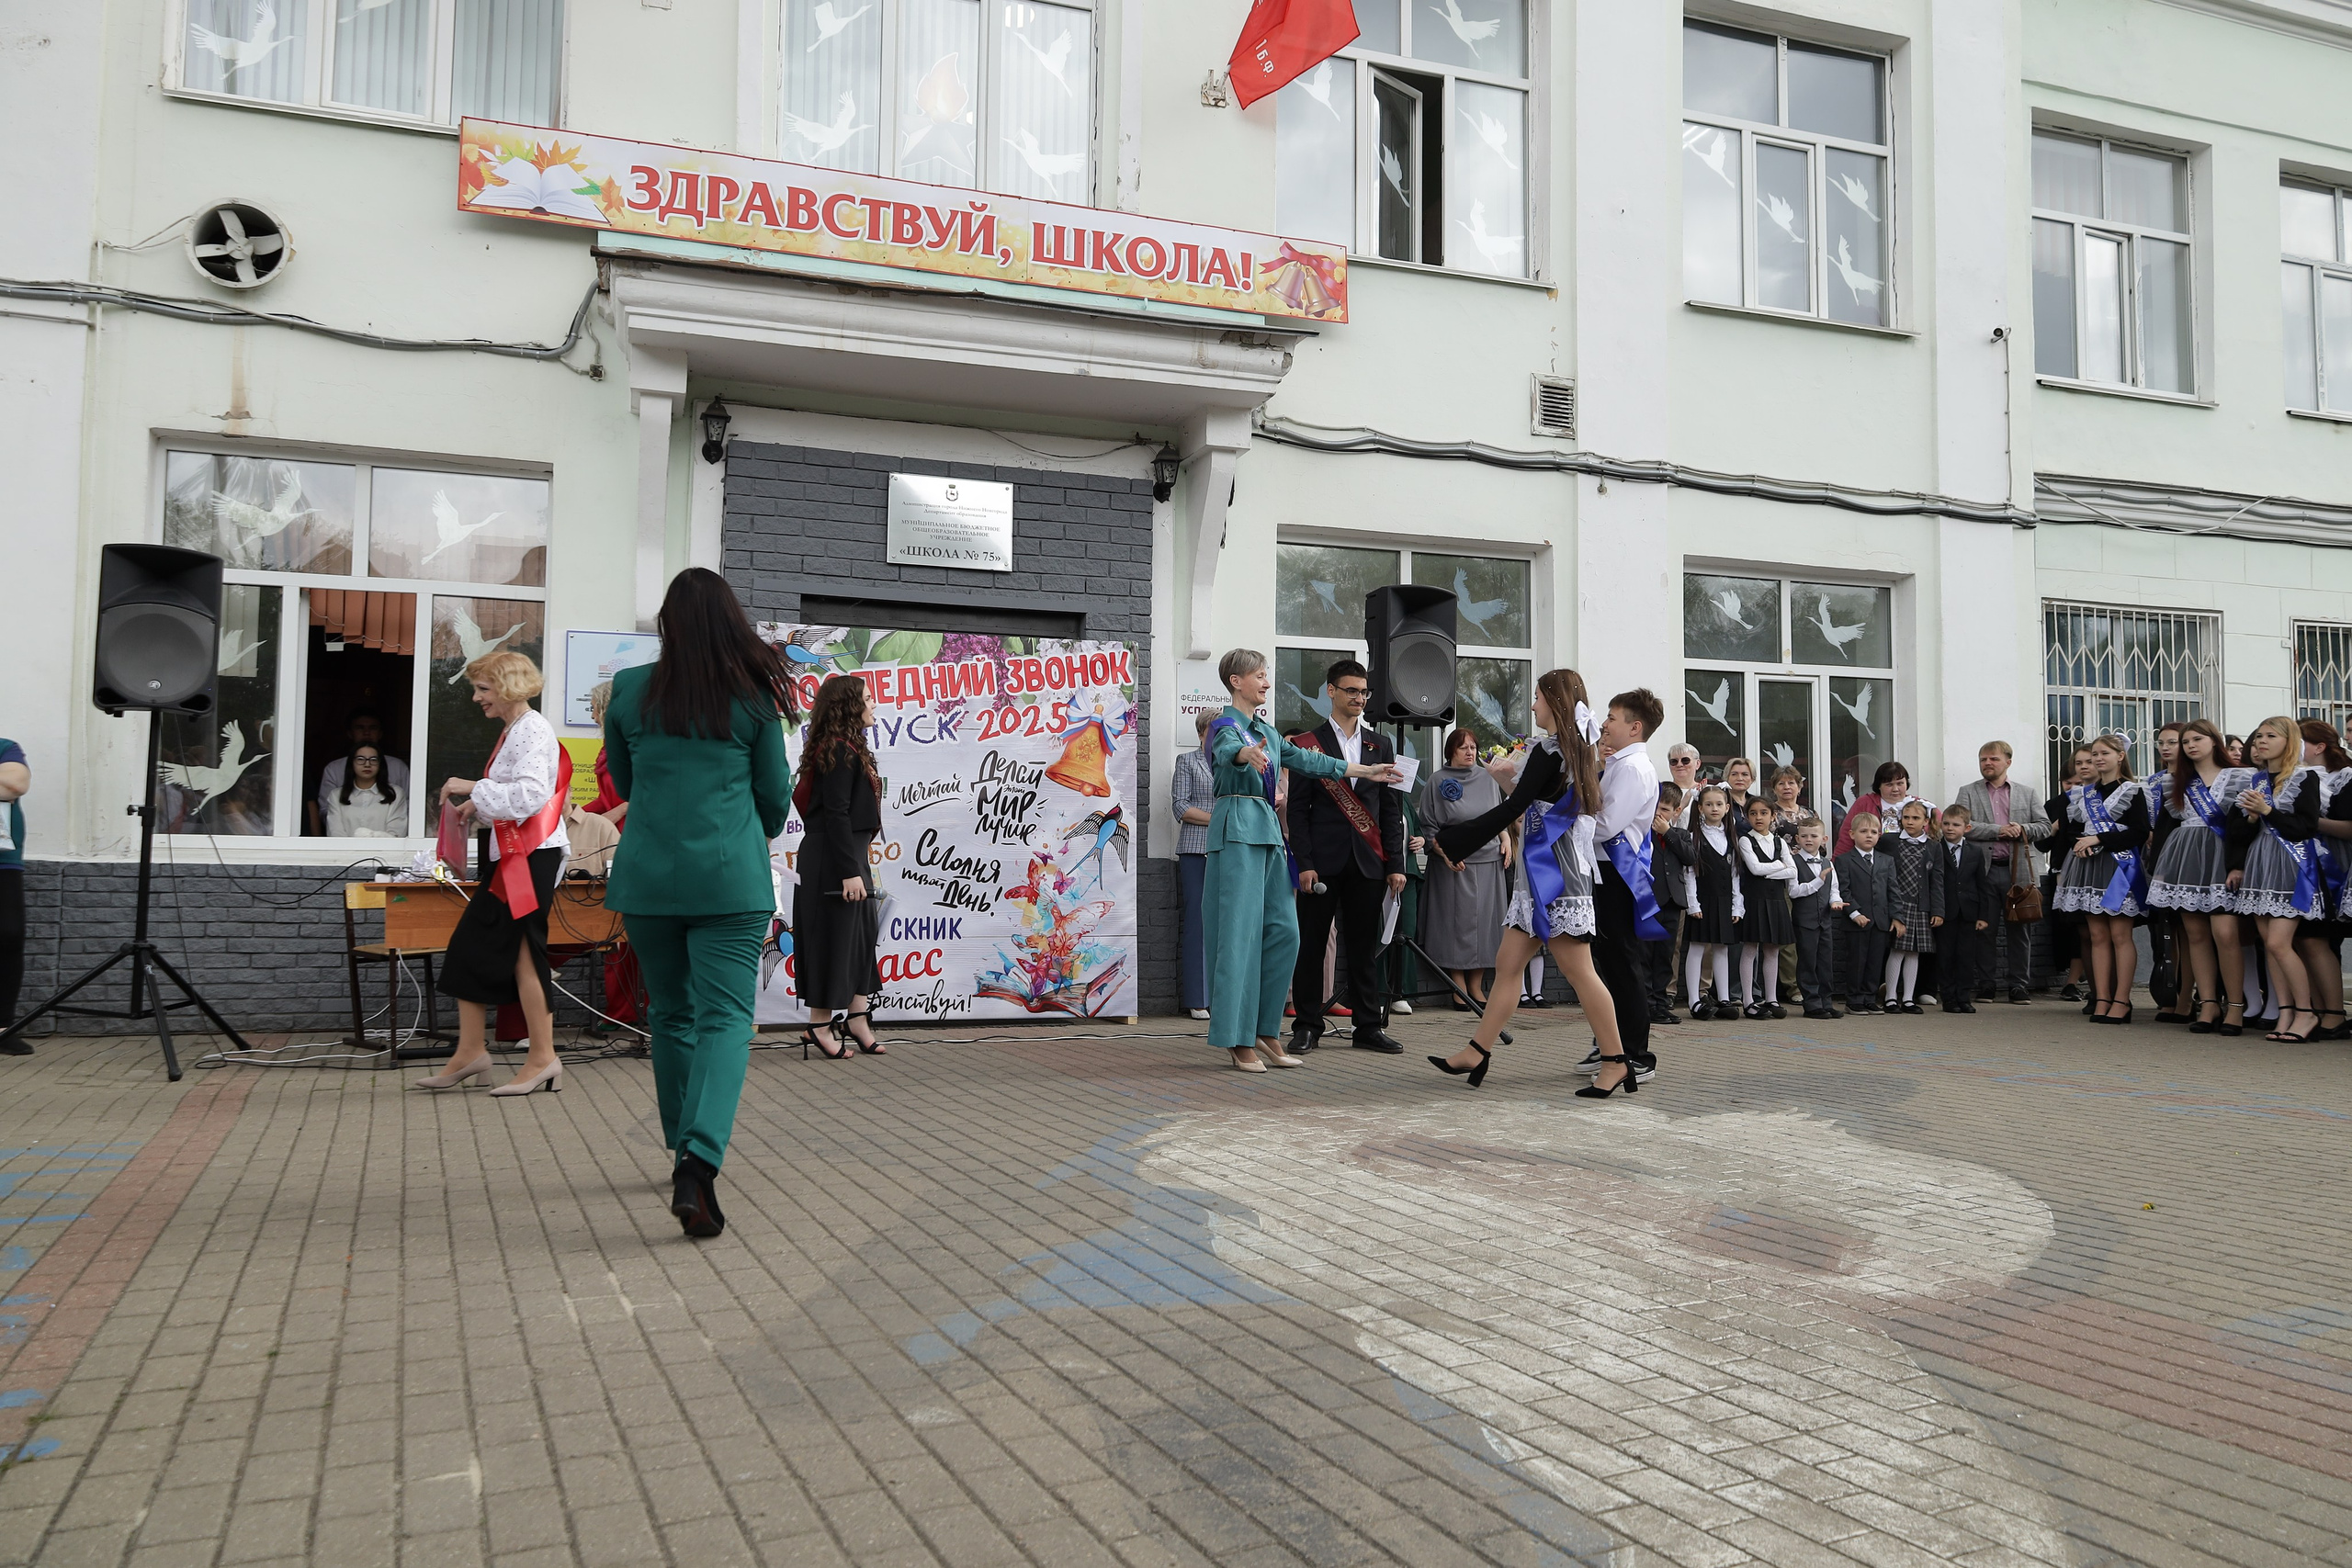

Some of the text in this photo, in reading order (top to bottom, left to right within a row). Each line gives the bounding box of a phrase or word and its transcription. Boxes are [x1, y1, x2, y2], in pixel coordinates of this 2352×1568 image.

[627, 164, 1253, 292] ЗДРАВСТВУЙ, ШКОЛА!
[899, 546, 1001, 562] «ШКОЛА № 75»
[771, 651, 1131, 713] ПОЕДНИЙ ЗВОНОК
[1181, 694, 1232, 703] ФЕДЕРАЛЬНЫ
[801, 702, 1070, 750] УСК 2025
[970, 750, 1046, 794] Делай
[893, 773, 963, 811] Мечтай
[916, 829, 1001, 885] Сегодня
[901, 867, 947, 890] твой
[891, 916, 963, 942] СКНИК
[877, 948, 943, 984] асс
